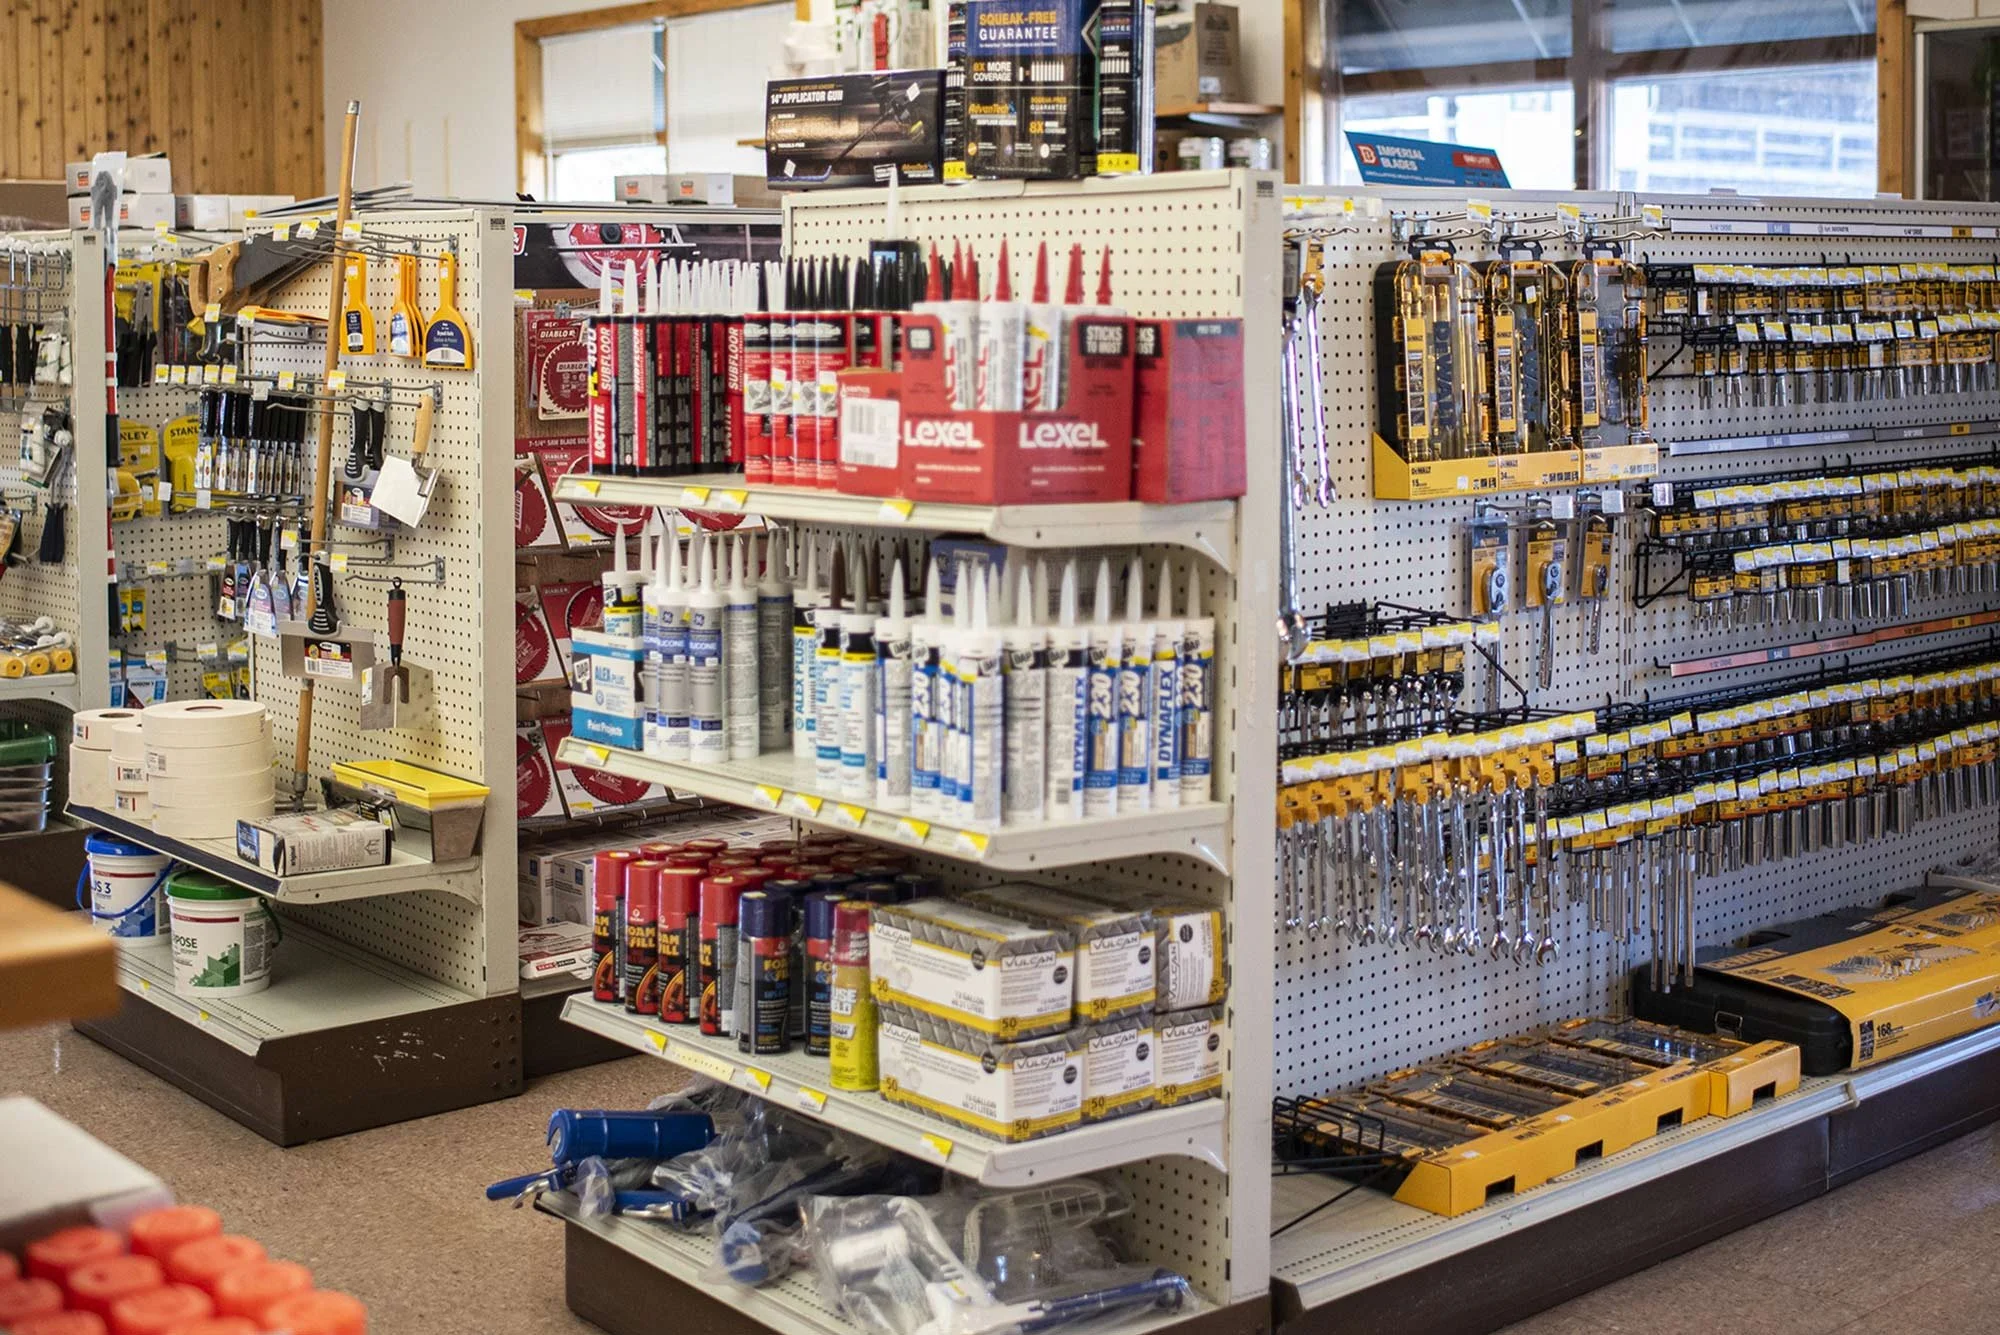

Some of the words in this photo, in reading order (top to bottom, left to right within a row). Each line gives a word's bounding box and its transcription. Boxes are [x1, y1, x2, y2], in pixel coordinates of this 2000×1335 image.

[979, 11, 1056, 26] SQUEAK-FREE
[979, 26, 1057, 40] GUARANTEE
[987, 61, 1012, 72] MORE
[973, 72, 1012, 82] COVERAGE
[783, 91, 826, 104] APPLICATOR
[827, 90, 843, 101] GUN
[540, 330, 568, 338] DIABLO
[1086, 326, 1123, 342] STICKS
[600, 327, 611, 390] SUBFLOOR
[728, 327, 739, 390] SUBFLOOR
[120, 431, 149, 441] NLEY
[170, 426, 199, 437] STANL
[593, 404, 606, 459] LOCTITE
[794, 638, 805, 674] PLUS
[1014, 652, 1032, 664] DAP
[1050, 651, 1066, 661] DAP
[595, 665, 611, 682] ALEX
[1184, 663, 1203, 708] 230
[795, 678, 805, 715] ALEX
[1091, 672, 1112, 718] 230
[1120, 670, 1140, 719] 230
[1158, 669, 1174, 762] DYNAFLEX
[1073, 677, 1085, 771] DYNAFLEX
[104, 882, 112, 895] 3
[627, 925, 656, 937] OAM
[877, 923, 910, 943] VULCAN
[1094, 935, 1138, 950] VULCAN
[1005, 954, 1053, 969] VULCAN
[1169, 945, 1178, 1000] VULCAN
[1093, 998, 1107, 1010] 50
[1002, 1017, 1017, 1029] 50
[1166, 1023, 1208, 1038] VULCAN
[1877, 1022, 1891, 1037] 168
[886, 1024, 919, 1044] VULCAN
[1092, 1033, 1136, 1048] VULCAN
[1017, 1055, 1063, 1070] VULCAN
[886, 1076, 898, 1092] 50
[1163, 1084, 1177, 1096] 50
[1091, 1096, 1105, 1109] 50
[1015, 1119, 1029, 1131] 50
